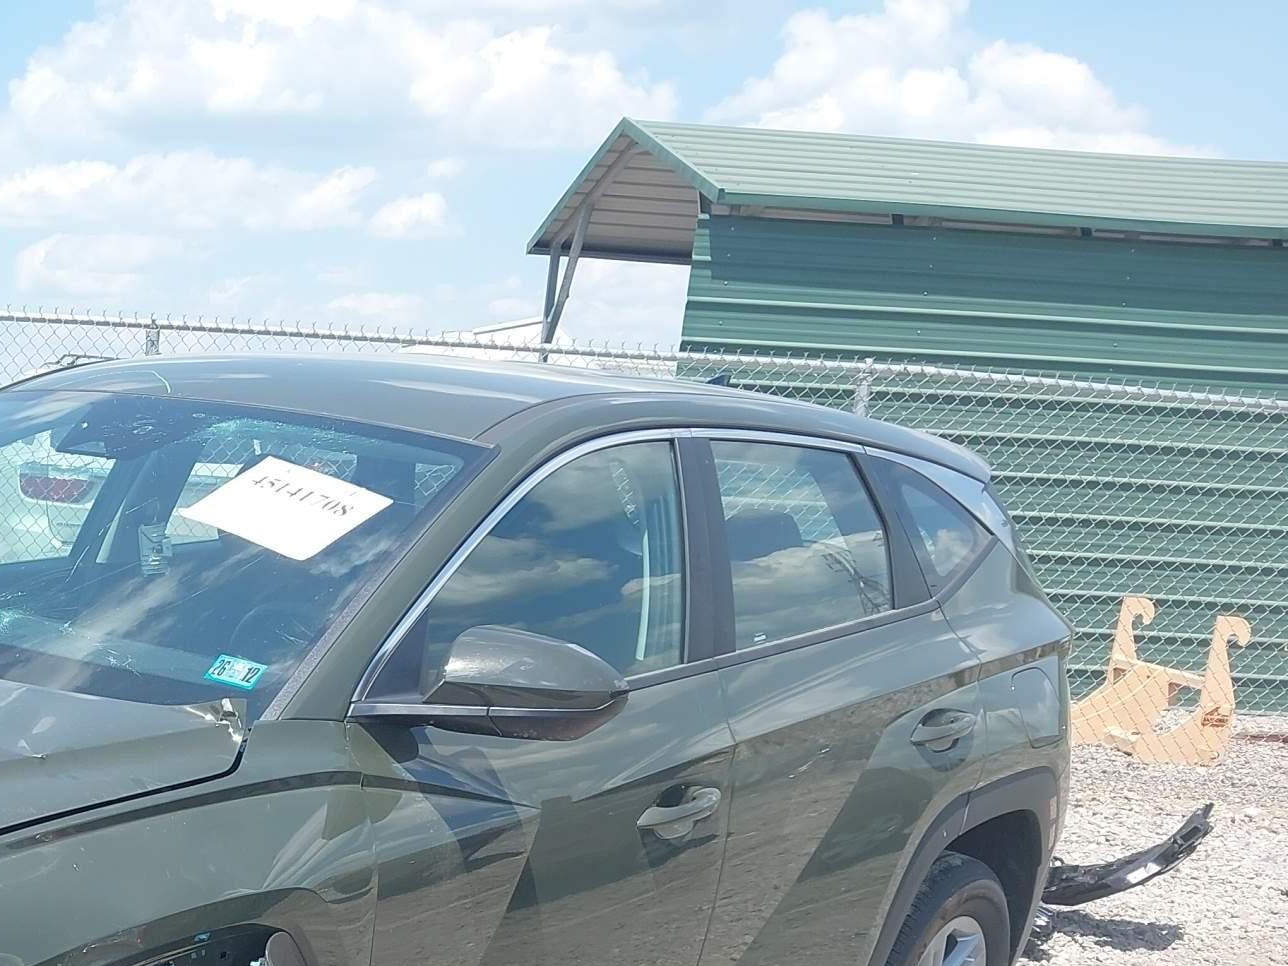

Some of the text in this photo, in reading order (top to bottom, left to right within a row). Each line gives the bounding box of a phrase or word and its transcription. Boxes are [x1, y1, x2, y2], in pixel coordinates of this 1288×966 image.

[252, 475, 355, 516] 45141708
[212, 659, 232, 677] 26
[240, 666, 261, 684] 12
